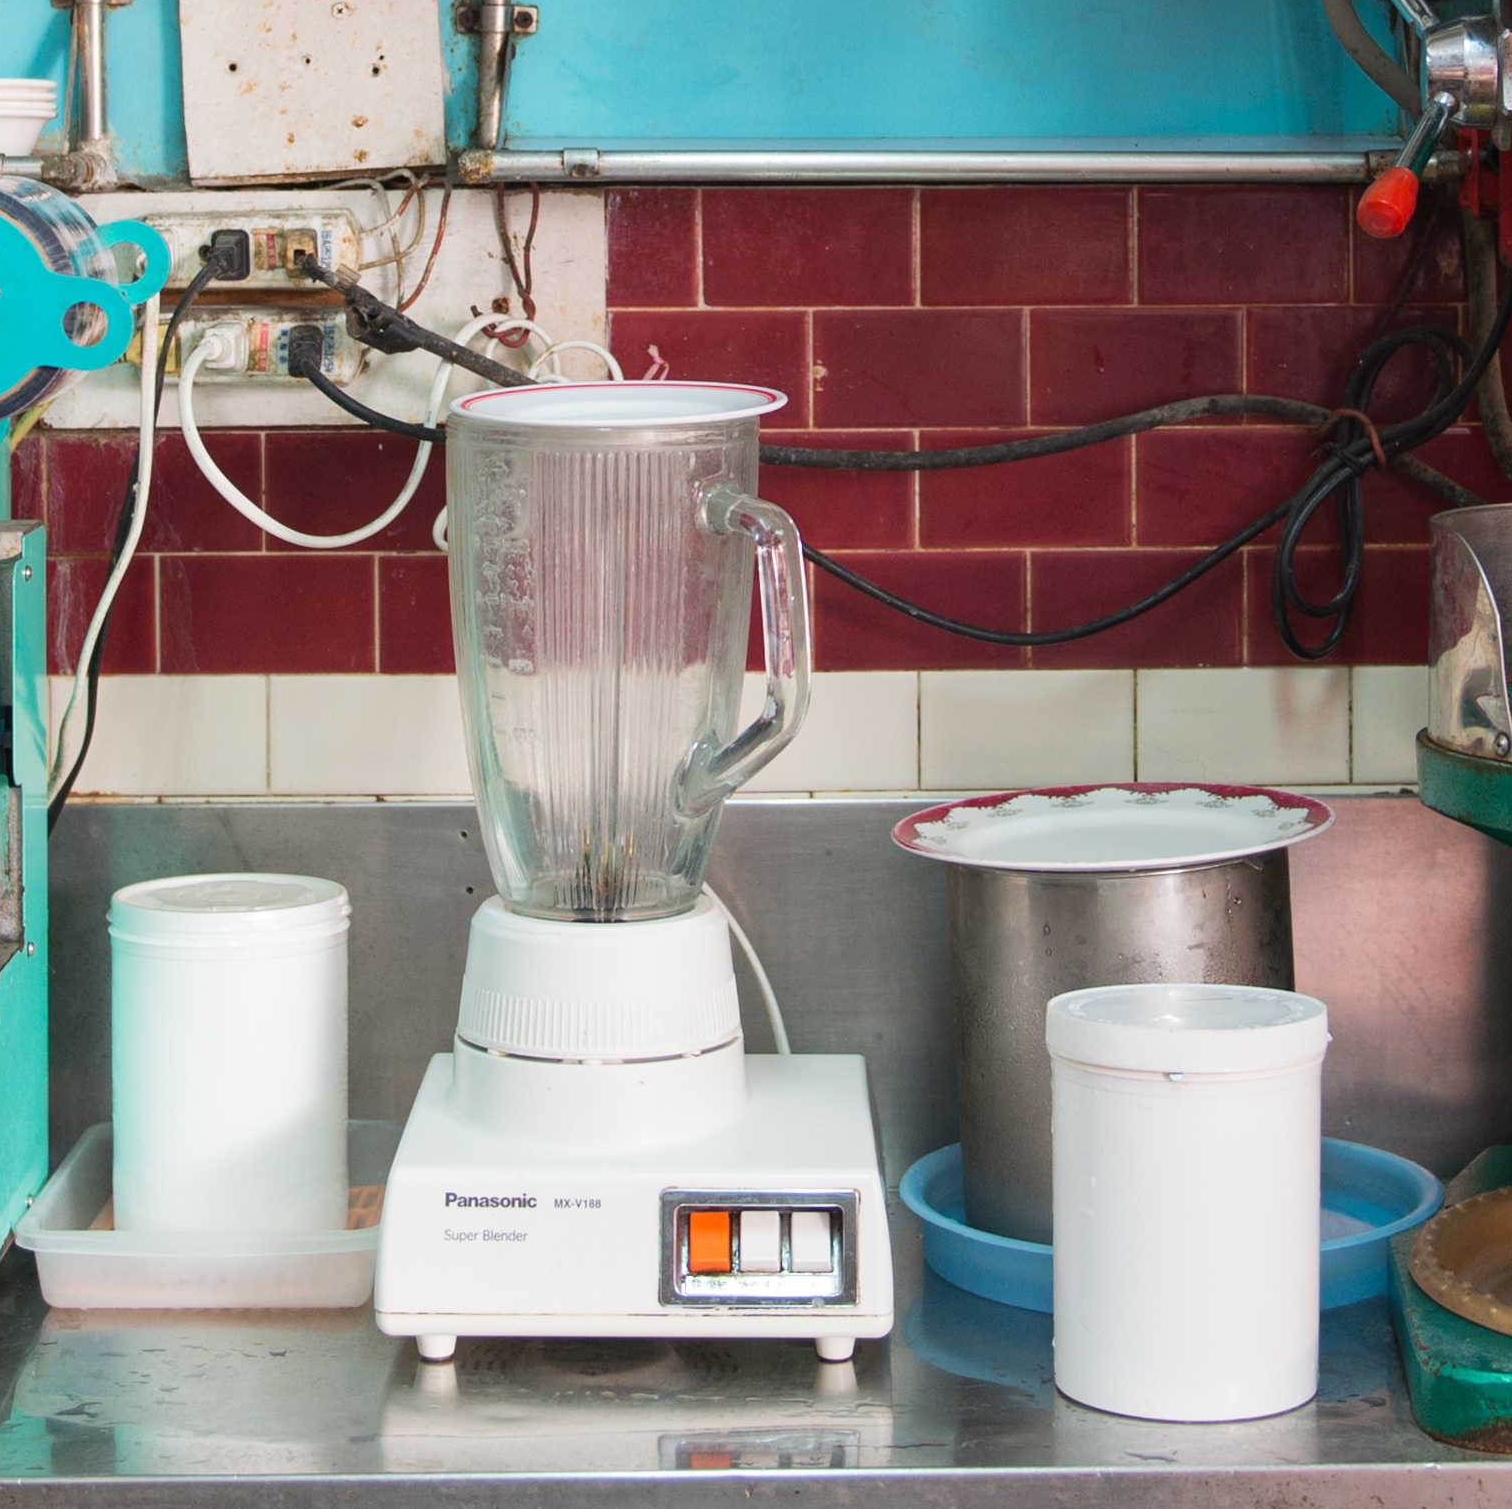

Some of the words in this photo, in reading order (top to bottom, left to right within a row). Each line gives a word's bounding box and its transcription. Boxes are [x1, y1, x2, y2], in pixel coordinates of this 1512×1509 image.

[445, 1192, 537, 1209] Panasonic
[554, 1198, 602, 1209] MX-V188
[444, 1229, 478, 1243] Super
[482, 1229, 528, 1241] Blender
